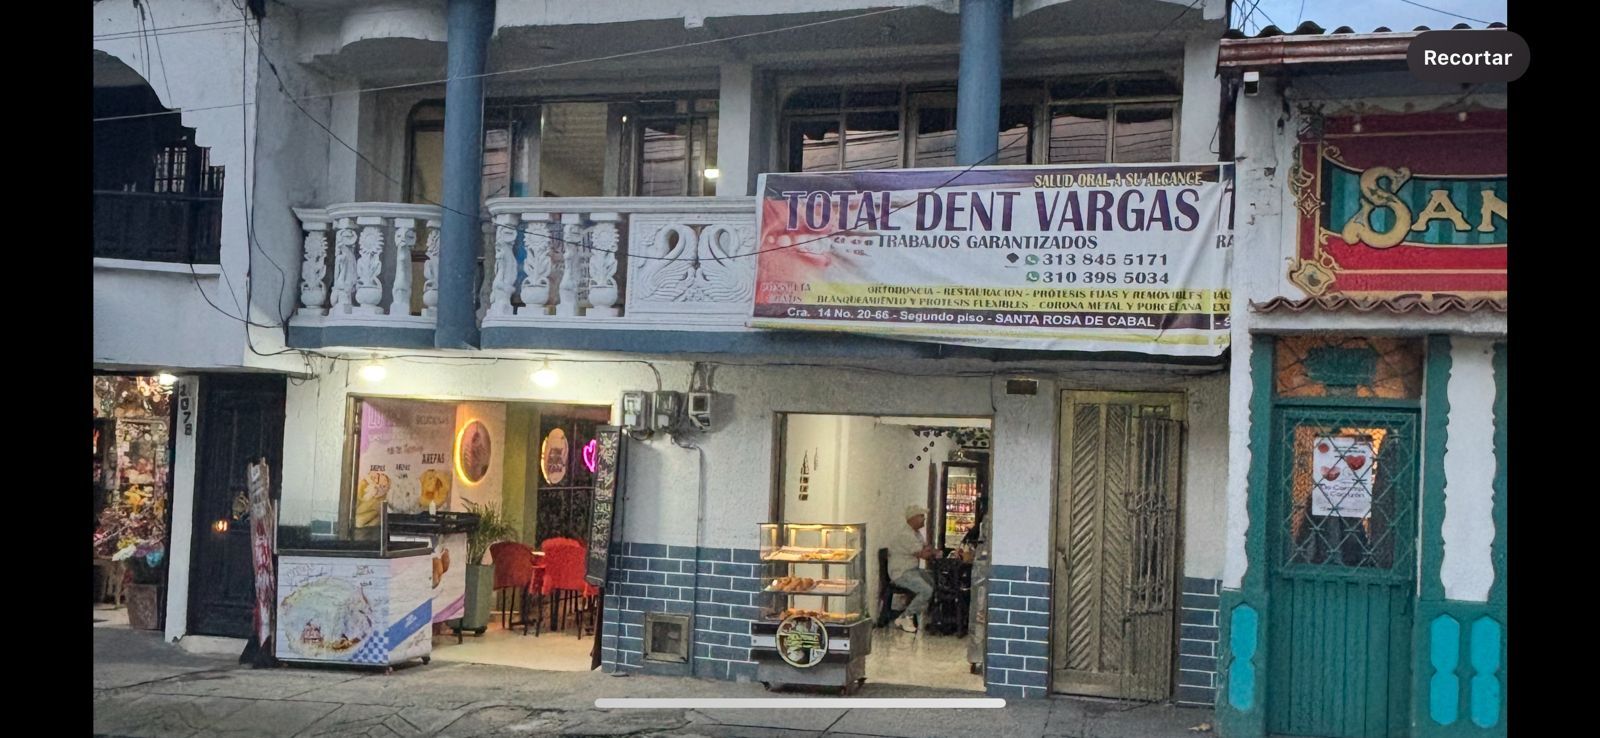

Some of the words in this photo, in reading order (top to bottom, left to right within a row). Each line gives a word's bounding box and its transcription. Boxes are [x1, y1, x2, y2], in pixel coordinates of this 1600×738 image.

[1033, 174, 1074, 188] SALUD
[1077, 173, 1110, 187] ORAL
[1112, 173, 1123, 187] A
[1125, 172, 1143, 187] SU
[1144, 171, 1203, 187] ALCANCE
[782, 190, 901, 231] TOTAL
[915, 190, 1021, 231] DENT
[1034, 188, 1201, 232] VARGAS
[878, 234, 960, 249] TRABAJOS
[966, 234, 1098, 249] GARANTIZADOS
[1042, 253, 1076, 266] 313
[1082, 253, 1117, 266] 845
[1123, 253, 1168, 266] 5171
[1042, 271, 1077, 284] 310
[1082, 271, 1117, 284] 398
[1123, 271, 1170, 284] 5034
[867, 285, 934, 295] ORTODONCIA
[1089, 290, 1118, 299] FIJAS
[1122, 290, 1129, 299] Y
[1132, 290, 1202, 300] REMOVIBLES
[817, 296, 907, 306] BLANQUEAMIENTO
[910, 297, 918, 306] Y
[973, 299, 1028, 309] FLEXIBLES
[1039, 302, 1084, 310] CORONA
[1088, 302, 1124, 310] METAL
[1127, 302, 1133, 310] Y
[1136, 302, 1202, 311] PORCELANA
[787, 307, 810, 318] Cra.
[818, 308, 831, 318] 14
[834, 308, 854, 319] No.
[899, 310, 954, 323] Segundo
[957, 313, 984, 324] piso
[995, 313, 1040, 325] SANTA
[1042, 315, 1082, 326] ROSA
[1084, 315, 1104, 326] DE
[1107, 316, 1156, 327] CABAL
